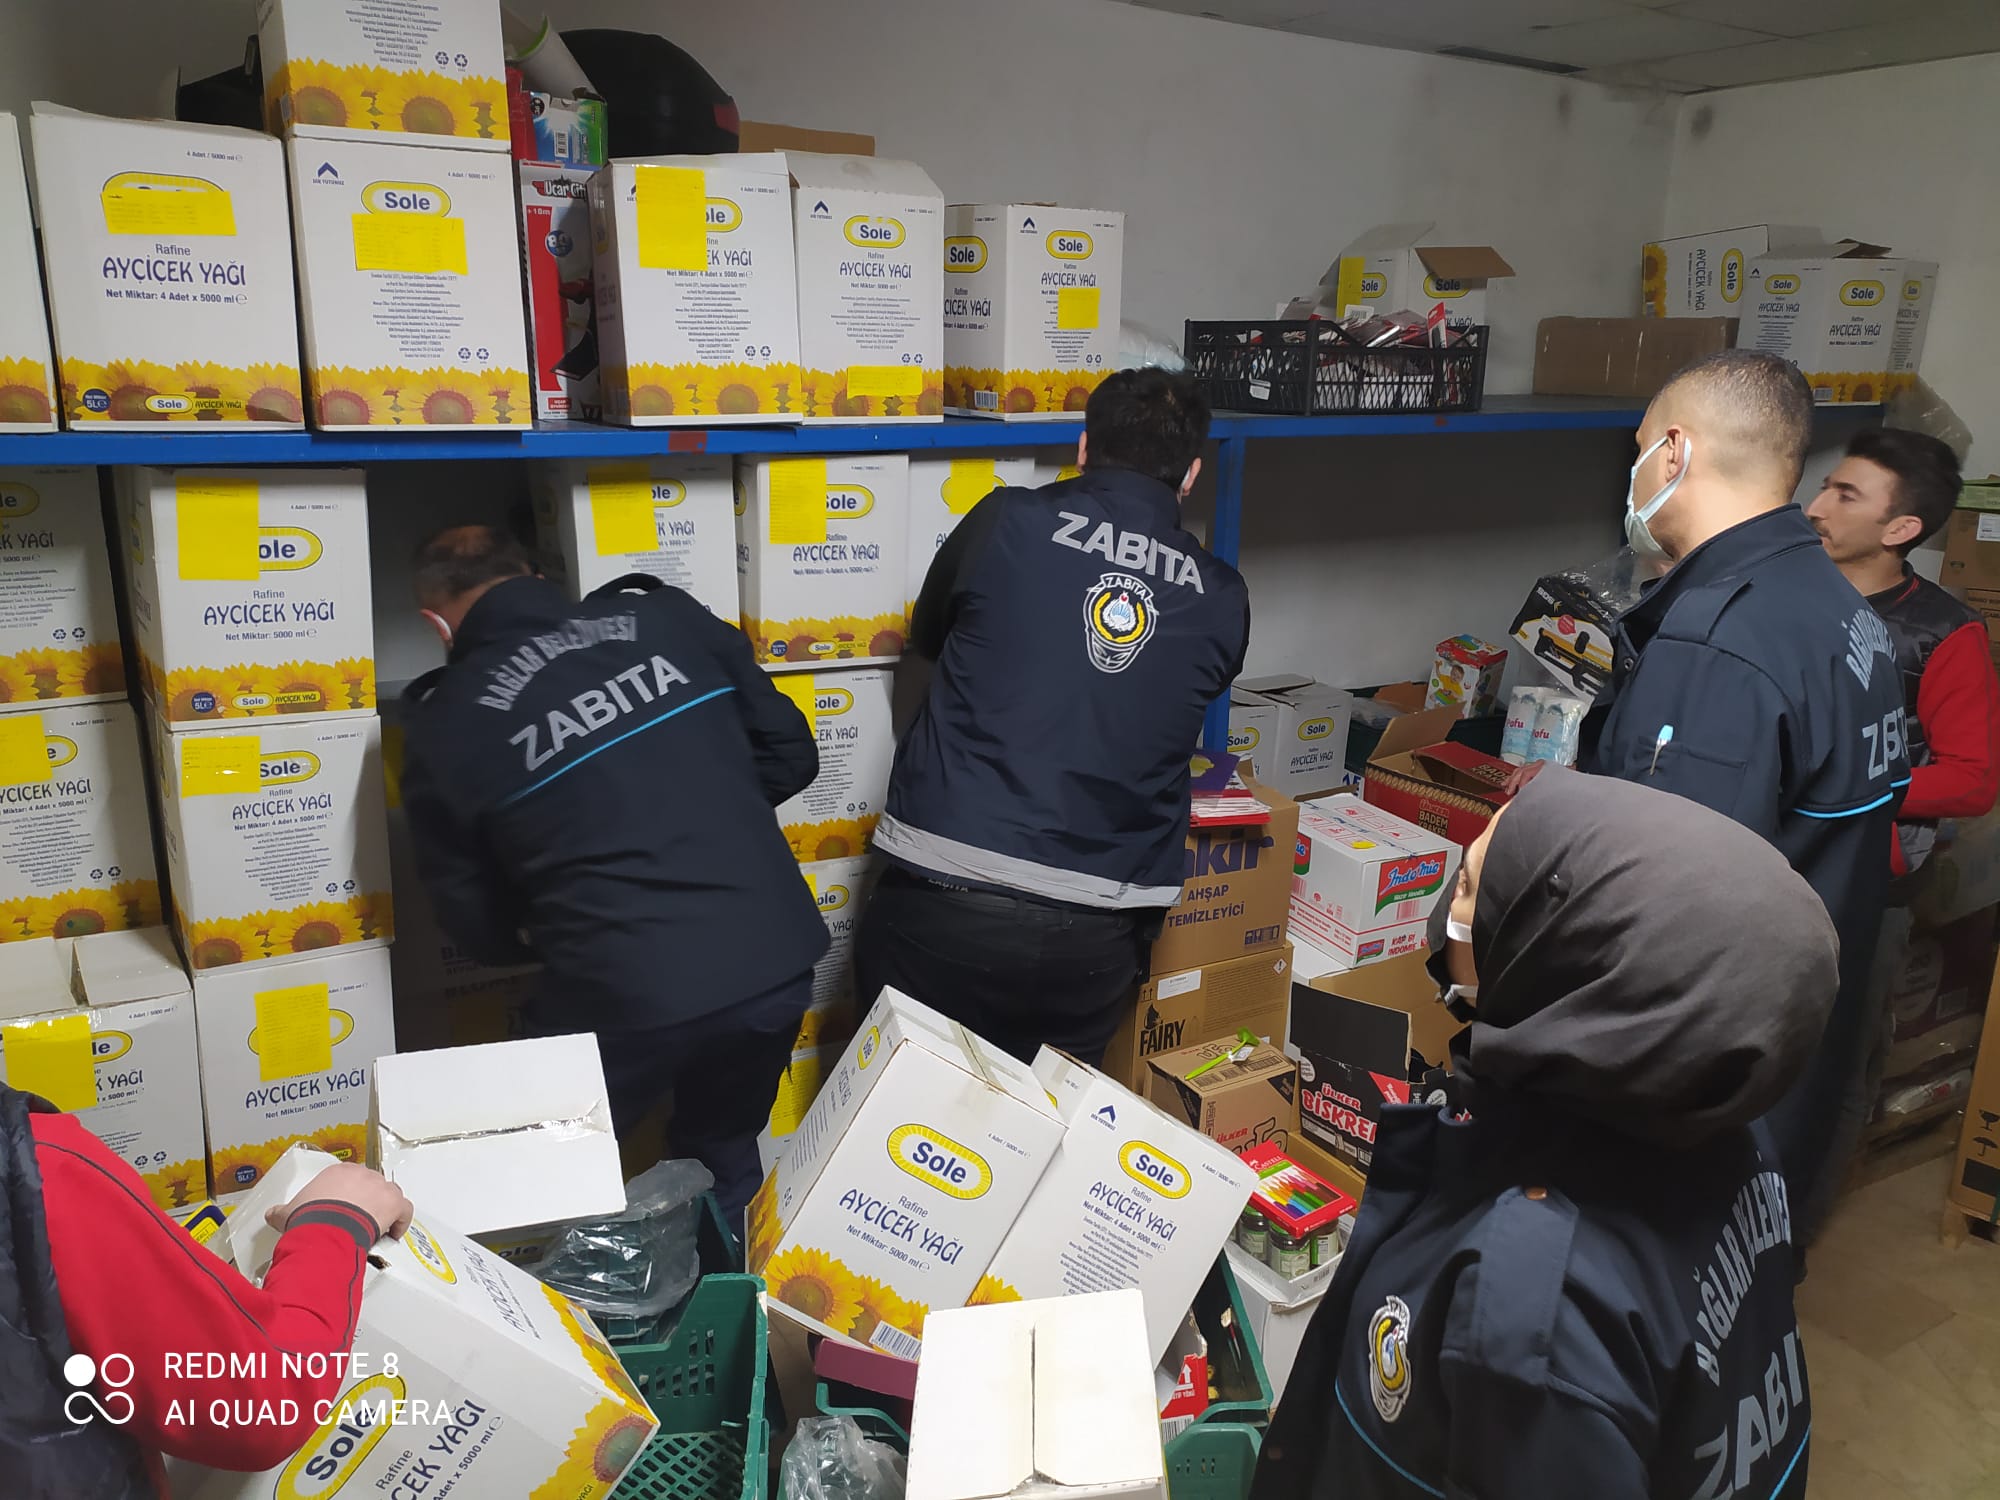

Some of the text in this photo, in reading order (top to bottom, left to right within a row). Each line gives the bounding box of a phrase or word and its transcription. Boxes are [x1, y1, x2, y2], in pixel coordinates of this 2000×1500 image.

[384, 191, 430, 211] Sole
[705, 207, 726, 223] le
[706, 237, 718, 245] fine
[860, 224, 892, 240] Sole
[155, 243, 191, 256] Rafine
[1058, 238, 1083, 252] Sole
[724, 248, 752, 266] YAĞI
[950, 246, 975, 264] Sole
[102, 255, 246, 286] AYÇİÇEK YAĞI
[840, 260, 912, 280] AYÇİÇEK YAĞI
[1727, 263, 1738, 290] Sole
[1041, 272, 1096, 288] AYÇİÇEK YAĞI
[1361, 280, 1378, 292] Sole
[1435, 278, 1460, 291] Sole
[1773, 280, 1792, 290] Sole
[106, 289, 123, 298] Net
[125, 289, 158, 300] Miktar:
[161, 292, 166, 300] 4
[169, 292, 190, 302] Adet
[200, 293, 222, 303] 5000
[1850, 288, 1874, 300] Sole
[944, 297, 992, 317] ÇİÇEK YAĞI
[1829, 324, 1882, 336] AYÇİÇEK YAĞI
[157, 399, 182, 409] Sole
[0, 491, 17, 508] le
[652, 486, 671, 499] le
[17, 532, 54, 549] YAĞI
[826, 534, 847, 542] Rafine
[259, 539, 296, 559] ole
[793, 543, 880, 564] AYÇİÇEK YAĞI
[1051, 511, 1205, 594] ZABITA
[253, 589, 285, 600] Rafine
[1106, 576, 1147, 600] ZABITA
[204, 599, 336, 628] AYÇİÇEK YAĞI
[225, 632, 240, 641] Net
[242, 631, 272, 640] Miktar:
[273, 630, 293, 639] 5000
[242, 697, 264, 706] Sole
[509, 655, 691, 771] ZABITA
[836, 726, 859, 740] YAĞI
[1307, 724, 1326, 735] Sole
[1228, 735, 1250, 746] Sole
[260, 761, 300, 777] Sole
[0, 776, 92, 804] YÇİÇEK YAĞI
[269, 788, 293, 797] Rafine
[232, 793, 332, 820] AYÇİÇEK YAĞI
[1419, 811, 1448, 828] BADEM
[1187, 885, 1229, 902] AHŞAP
[1167, 901, 1245, 928] TEMİZLEYİCİ
[1139, 1019, 1185, 1056] FAIRY
[92, 1041, 111, 1056] le
[108, 1069, 143, 1089] YAĞI
[246, 1068, 366, 1109] AYÇİÇEK YAĞI
[1322, 1082, 1361, 1112] ÜLKER
[265, 1110, 279, 1119] Net
[280, 1106, 308, 1116] Miktar:
[309, 1101, 327, 1110] 5000
[1216, 1128, 1248, 1143] ÜLKER
[912, 1141, 966, 1184] Sole
[1135, 1154, 1174, 1187] Sole
[1255, 1155, 1283, 1171] CASTELL
[1131, 1186, 1152, 1204] Rafine
[898, 1195, 929, 1218] Rafine
[1089, 1181, 1178, 1241] AYÇİÇEK YAĞI
[839, 1189, 964, 1265] AYÇİÇEK YAĞI
[1083, 1201, 1094, 1212] Net
[1094, 1207, 1113, 1223] Miktar:
[1118, 1222, 1132, 1236] Adet
[1137, 1232, 1151, 1245] 5000
[846, 1224, 920, 1268] Net Miktar: 5000 ml
[1688, 1331, 1804, 1500] ZABI
[428, 1399, 487, 1456] YAĞI
[305, 1405, 378, 1481] Sole
[459, 1443, 482, 1472] 5000
[480, 1428, 493, 1445] ml
[376, 1449, 413, 1491] Rafine
